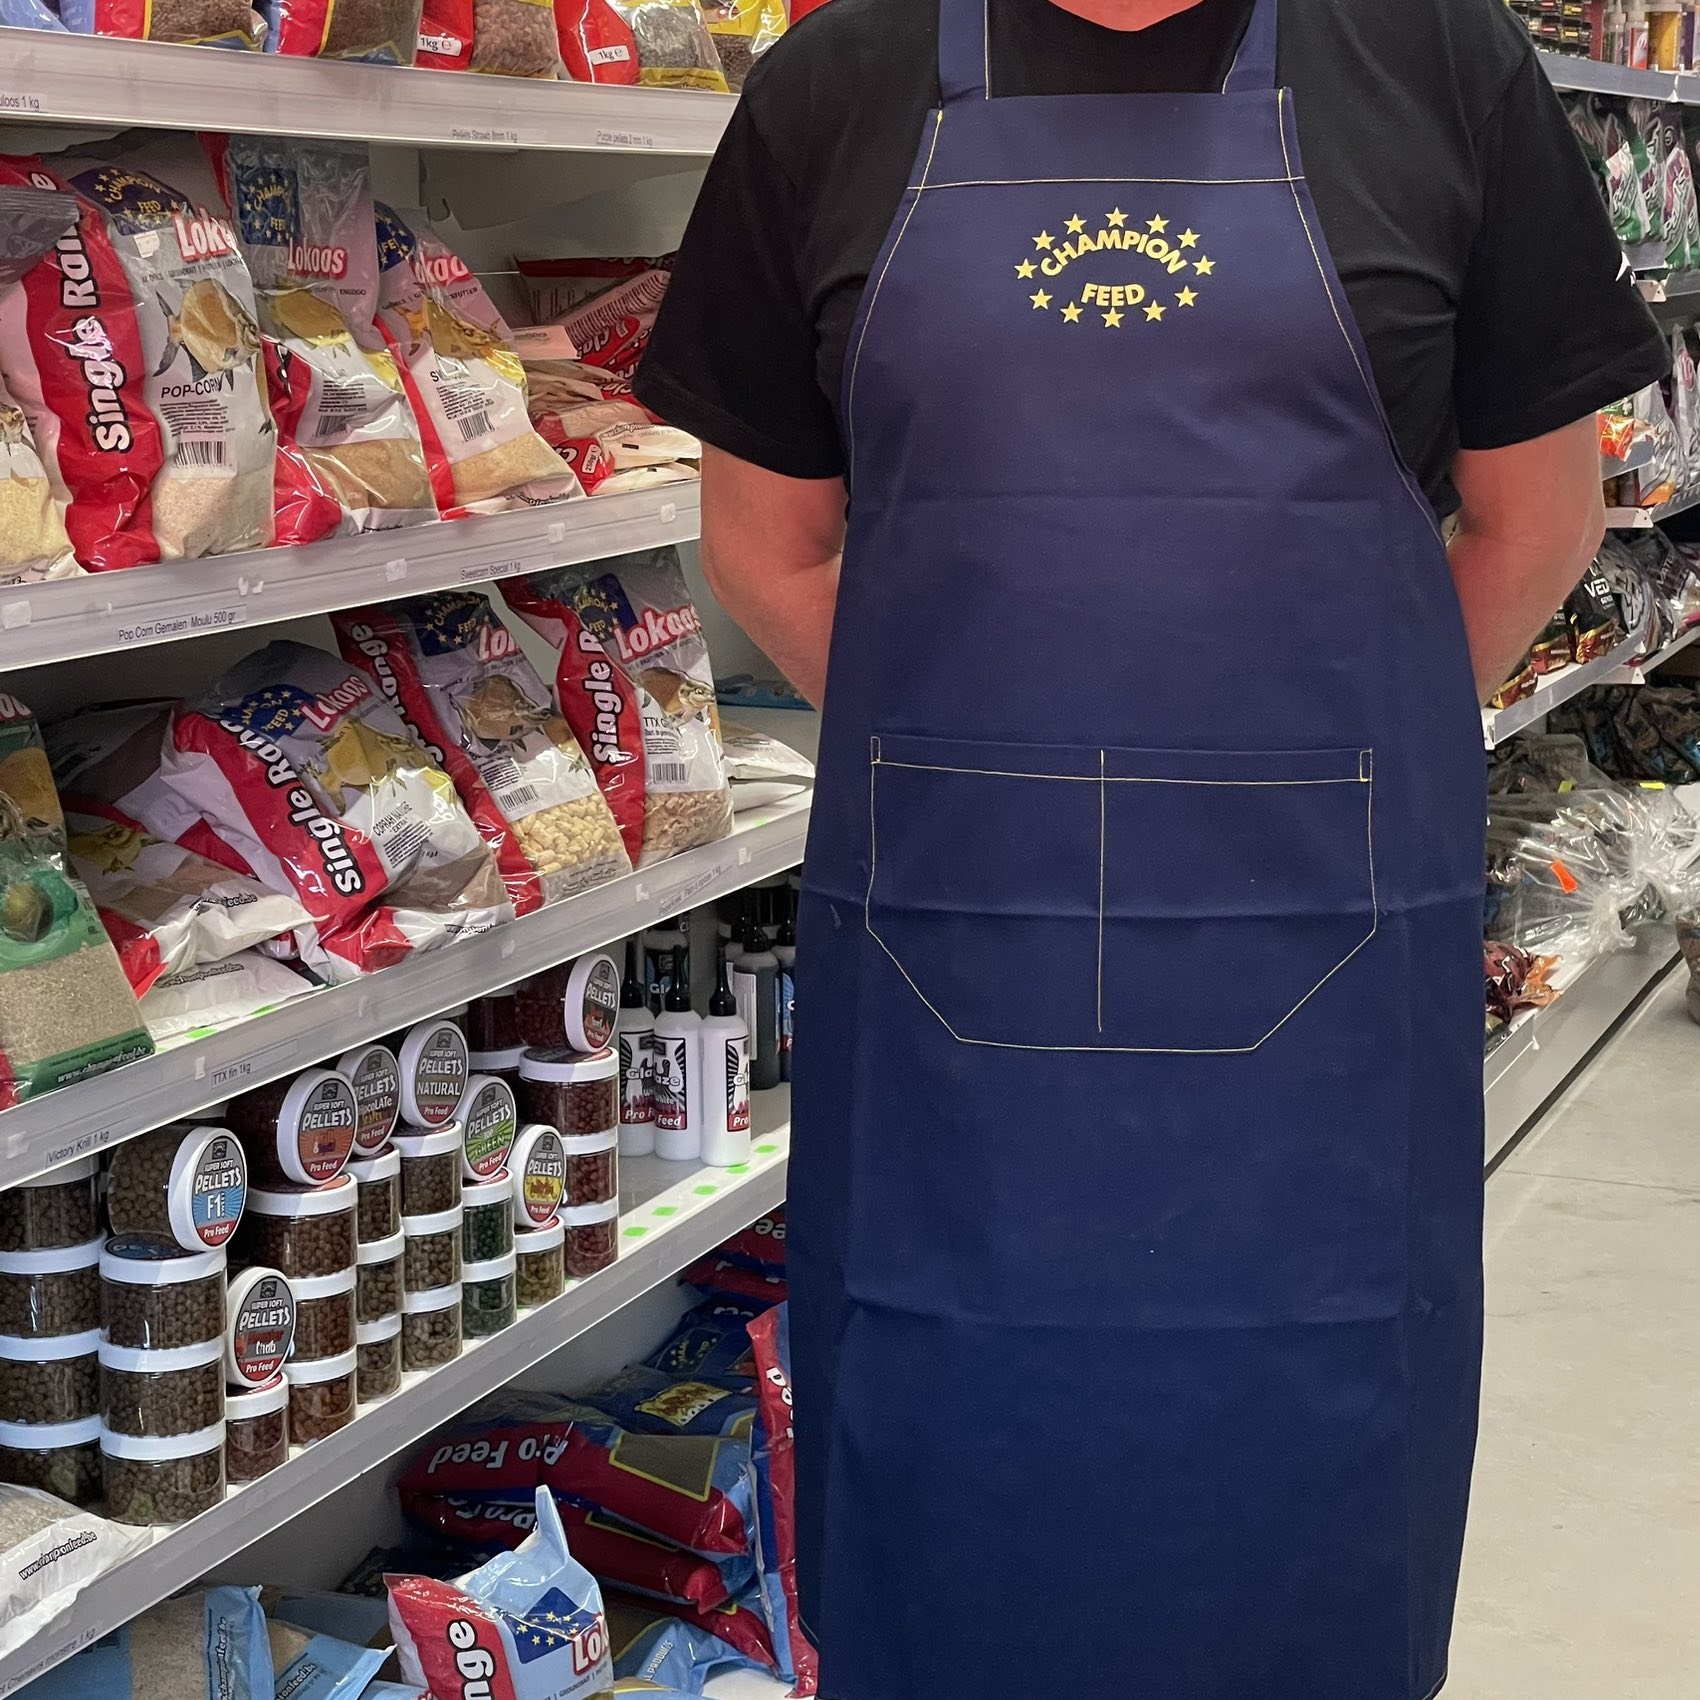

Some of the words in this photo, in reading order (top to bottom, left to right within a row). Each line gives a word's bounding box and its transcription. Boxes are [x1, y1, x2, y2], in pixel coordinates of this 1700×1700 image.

[29, 96, 40, 113] kg
[1040, 229, 1188, 276] CHAMPION
[1080, 282, 1145, 307] FEED
[160, 377, 222, 398] POP-CORN
[119, 629, 134, 642] Pop
[135, 625, 153, 638] Corn
[154, 619, 187, 635] Gemalen
[190, 614, 212, 628] Moulu
[213, 610, 227, 624] 500
[227, 611, 237, 625] gr
[584, 661, 622, 764] Single
[289, 789, 361, 893] Single
[586, 982, 616, 1009] PELLETS
[213, 1069, 227, 1085] TTX
[418, 1057, 463, 1076] PELLETS
[416, 1081, 461, 1096] NATURAL
[302, 1107, 352, 1132] PELLETS
[424, 1106, 434, 1115] Pro
[434, 1105, 449, 1115] Feed
[625, 1109, 646, 1121] Pro
[657, 1114, 682, 1127] Feed
[371, 1125, 385, 1138] Feed
[468, 1103, 511, 1139] PELLETS
[48, 1146, 75, 1163] Victory
[100, 1131, 109, 1143] kg
[474, 1132, 505, 1159] GREEN
[220, 1159, 234, 1170] SOFT
[310, 1163, 321, 1173] Pro
[321, 1160, 338, 1171] Feed
[478, 1161, 489, 1172] Pro
[489, 1151, 503, 1167] Feed
[527, 1158, 563, 1177] PELLETS
[194, 1166, 243, 1195] PELLETS
[207, 1191, 221, 1220] F1
[203, 1229, 215, 1239] Pro
[214, 1223, 230, 1237] Feed
[268, 1299, 284, 1309] SOFT
[239, 1305, 291, 1332] PELLETS
[245, 1363, 258, 1374] Pro
[258, 1360, 275, 1373] Feed
[426, 1439, 510, 1475] Feed
